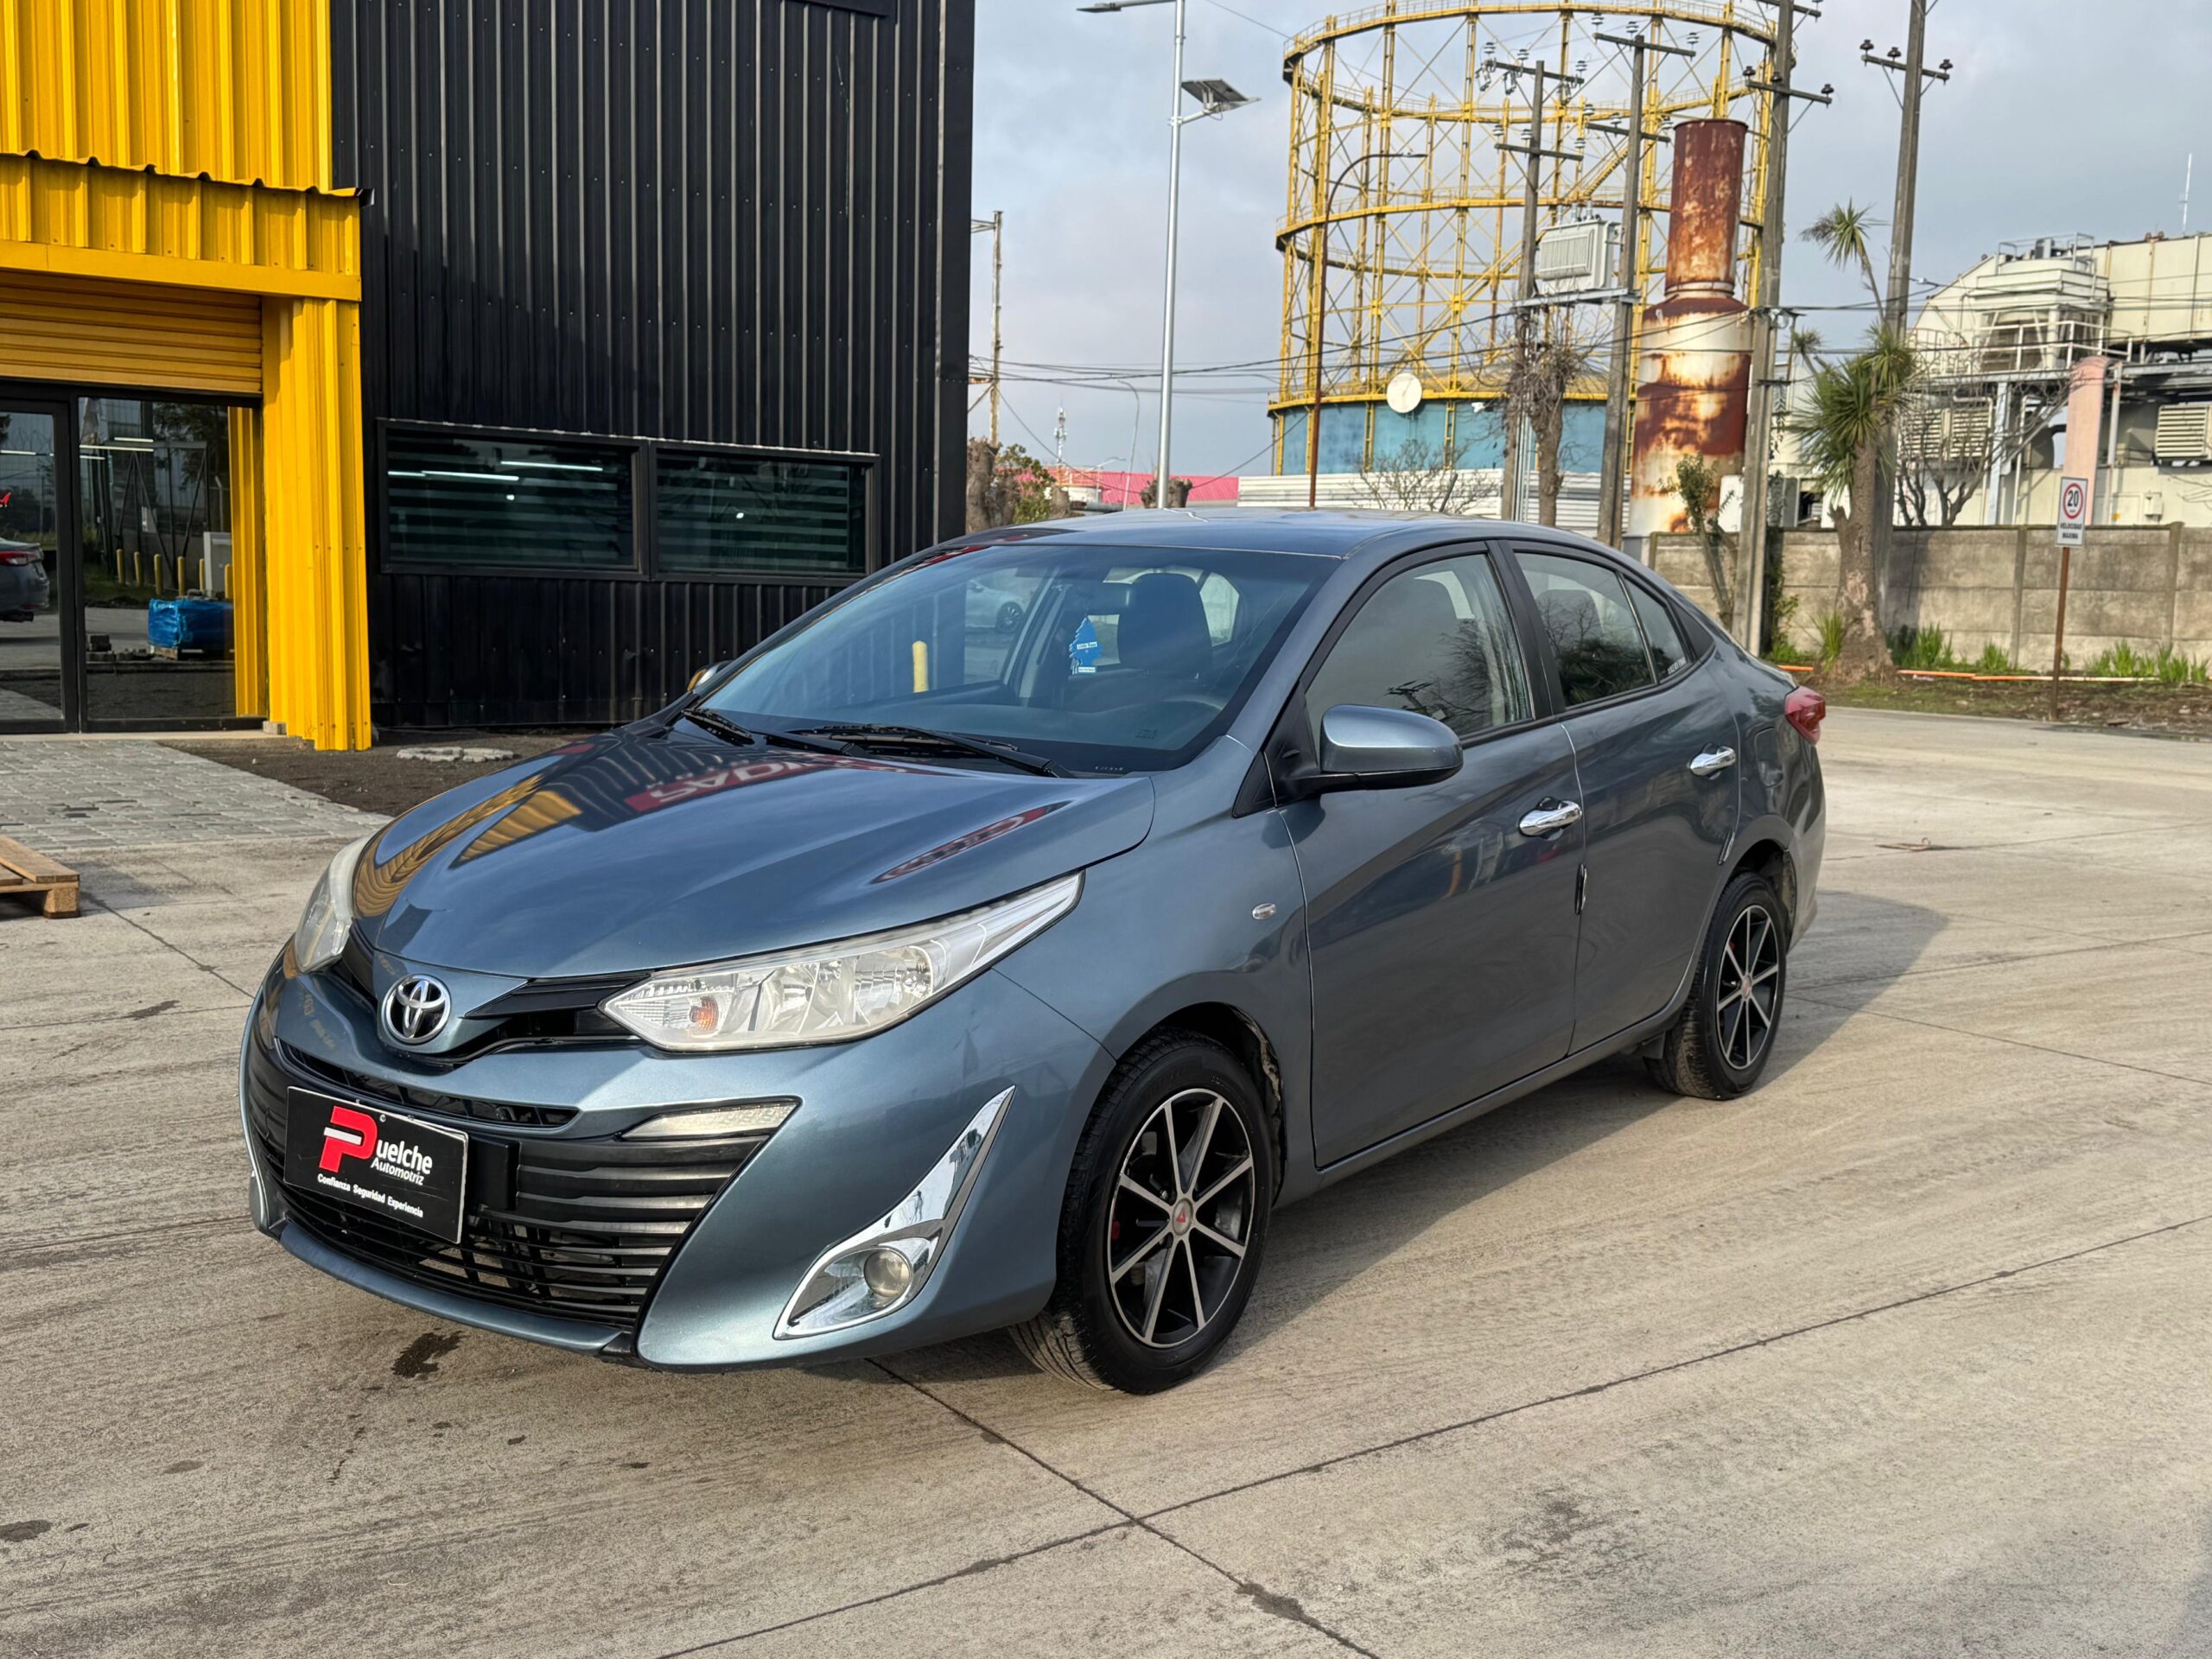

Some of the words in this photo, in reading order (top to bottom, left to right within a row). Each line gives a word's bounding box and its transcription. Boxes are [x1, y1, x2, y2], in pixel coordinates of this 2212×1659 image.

[2067, 490, 2080, 507] 20
[319, 1105, 433, 1175] Puelche
[371, 1160, 425, 1185] Automotriz
[317, 1173, 351, 1192] Confianza
[353, 1185, 385, 1204] Seguridad
[387, 1196, 423, 1217] Experiencia
